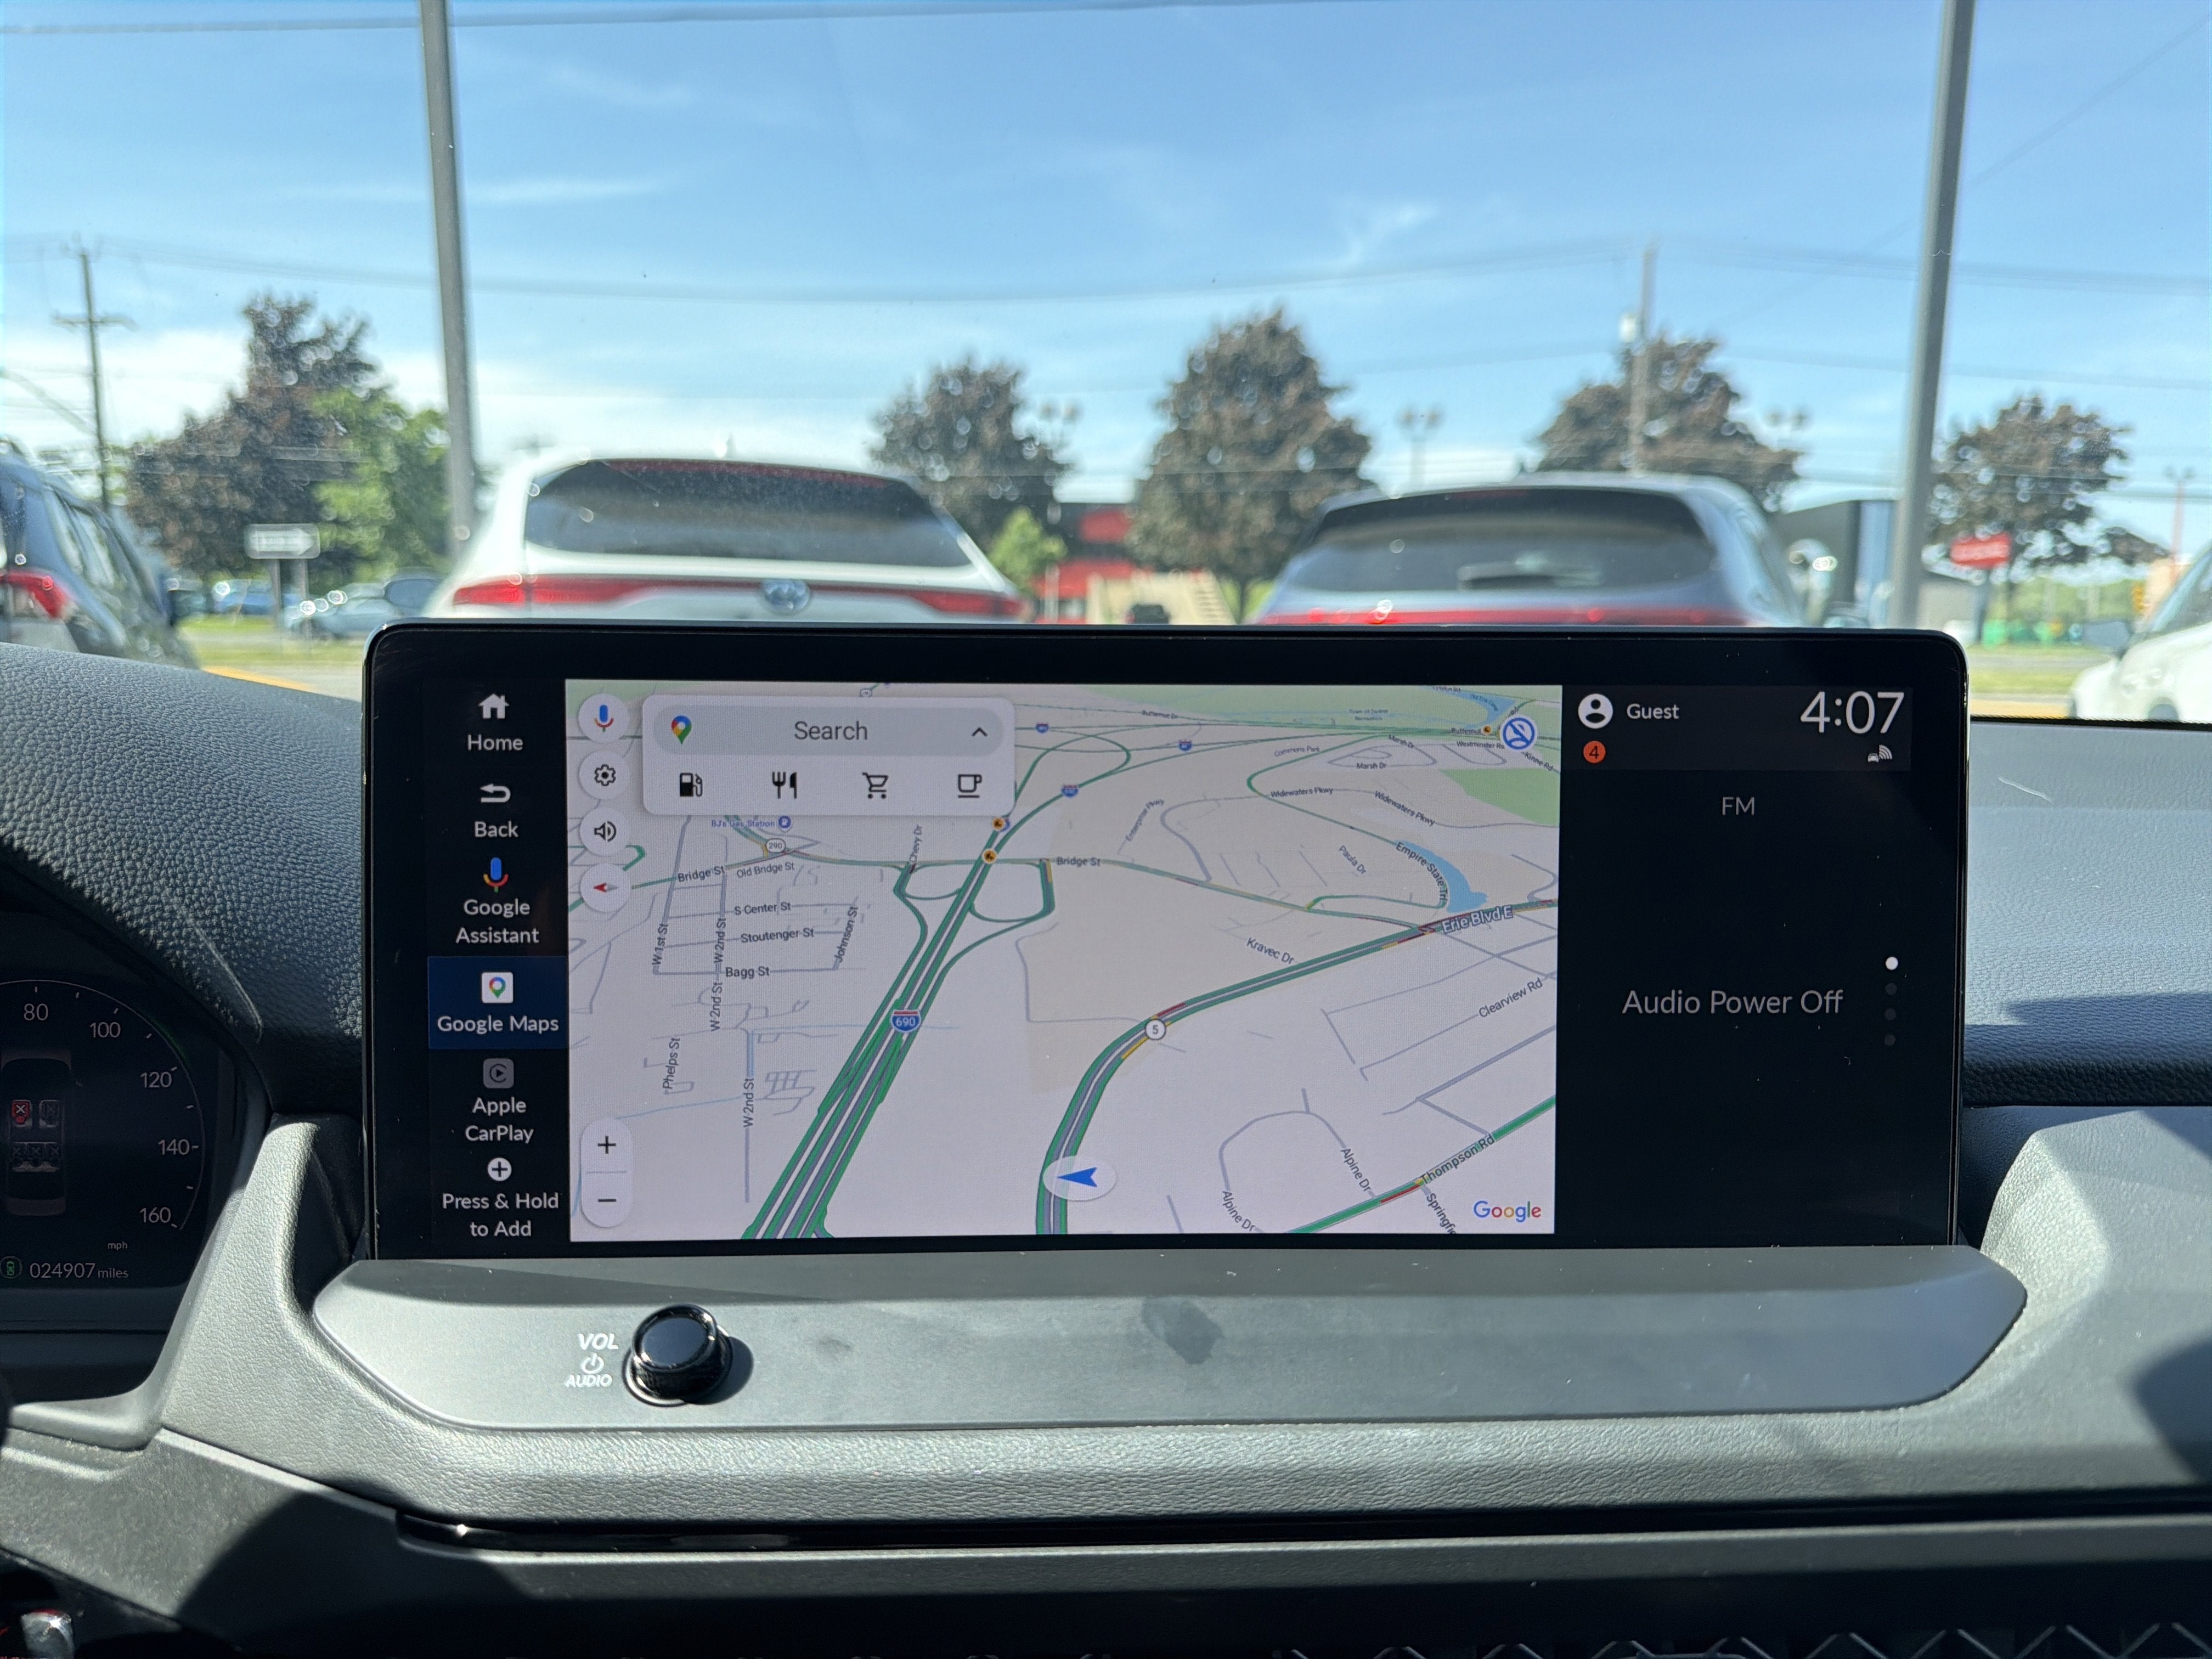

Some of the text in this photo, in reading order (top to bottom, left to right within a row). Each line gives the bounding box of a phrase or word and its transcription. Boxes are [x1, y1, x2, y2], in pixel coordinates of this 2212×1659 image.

[1627, 703, 1679, 720] Guest
[1800, 691, 1905, 734] 4:07
[794, 721, 868, 740] Search
[467, 735, 523, 751] Home
[1589, 746, 1600, 759] 4
[1271, 788, 1313, 797] Widewaters
[1375, 791, 1435, 826] Widewaters Pkwy
[1722, 797, 1756, 816] FM
[475, 821, 518, 837] Back
[914, 825, 923, 834] Dr
[1057, 857, 1101, 867] Bridge St
[1339, 845, 1367, 875] Paula Dr
[678, 866, 725, 882] Bridge St
[736, 862, 794, 878] Old Bridge St
[1396, 842, 1448, 901] Empire State Trl
[464, 899, 530, 918] Google
[735, 901, 791, 915] S Center St
[1442, 905, 1513, 933] Erie Blvd E
[456, 927, 539, 944] Assistant
[714, 917, 726, 963] W 2nd St
[741, 928, 814, 943] Stoutenger St
[834, 906, 858, 962] Johnson St
[652, 923, 669, 965] W 1st St
[1246, 937, 1294, 964] Kravec Dr
[725, 966, 770, 979] Bagg St
[710, 981, 723, 1031] W 2nd St
[1479, 977, 1543, 1018] Clearview Rd
[1622, 989, 1843, 1014] Audio Power Off
[24, 1003, 49, 1021] 80
[438, 1015, 559, 1034] Google Maps
[896, 1017, 916, 1026] 690
[1152, 1024, 1159, 1035] 5
[89, 1022, 121, 1039] 100
[662, 1037, 680, 1090] Phelps St
[140, 1071, 172, 1088] 120
[472, 1097, 527, 1116] Apple
[743, 1077, 754, 1127] W 2nd St
[465, 1125, 534, 1144] CarPlay
[158, 1139, 190, 1155] 140
[1420, 1133, 1495, 1184] Thompson Rd
[1341, 1148, 1372, 1192] Alpine Dr
[442, 1192, 558, 1209] Press & Hold
[140, 1207, 172, 1224] 160
[1222, 1190, 1256, 1232] Alpine Dr
[1473, 1200, 1542, 1223] Google
[470, 1221, 531, 1237] to Add
[108, 1241, 128, 1250] mph
[30, 1263, 128, 1279] 024907 miles
[578, 1334, 619, 1350] VOL
[565, 1374, 612, 1388] AUDIO
